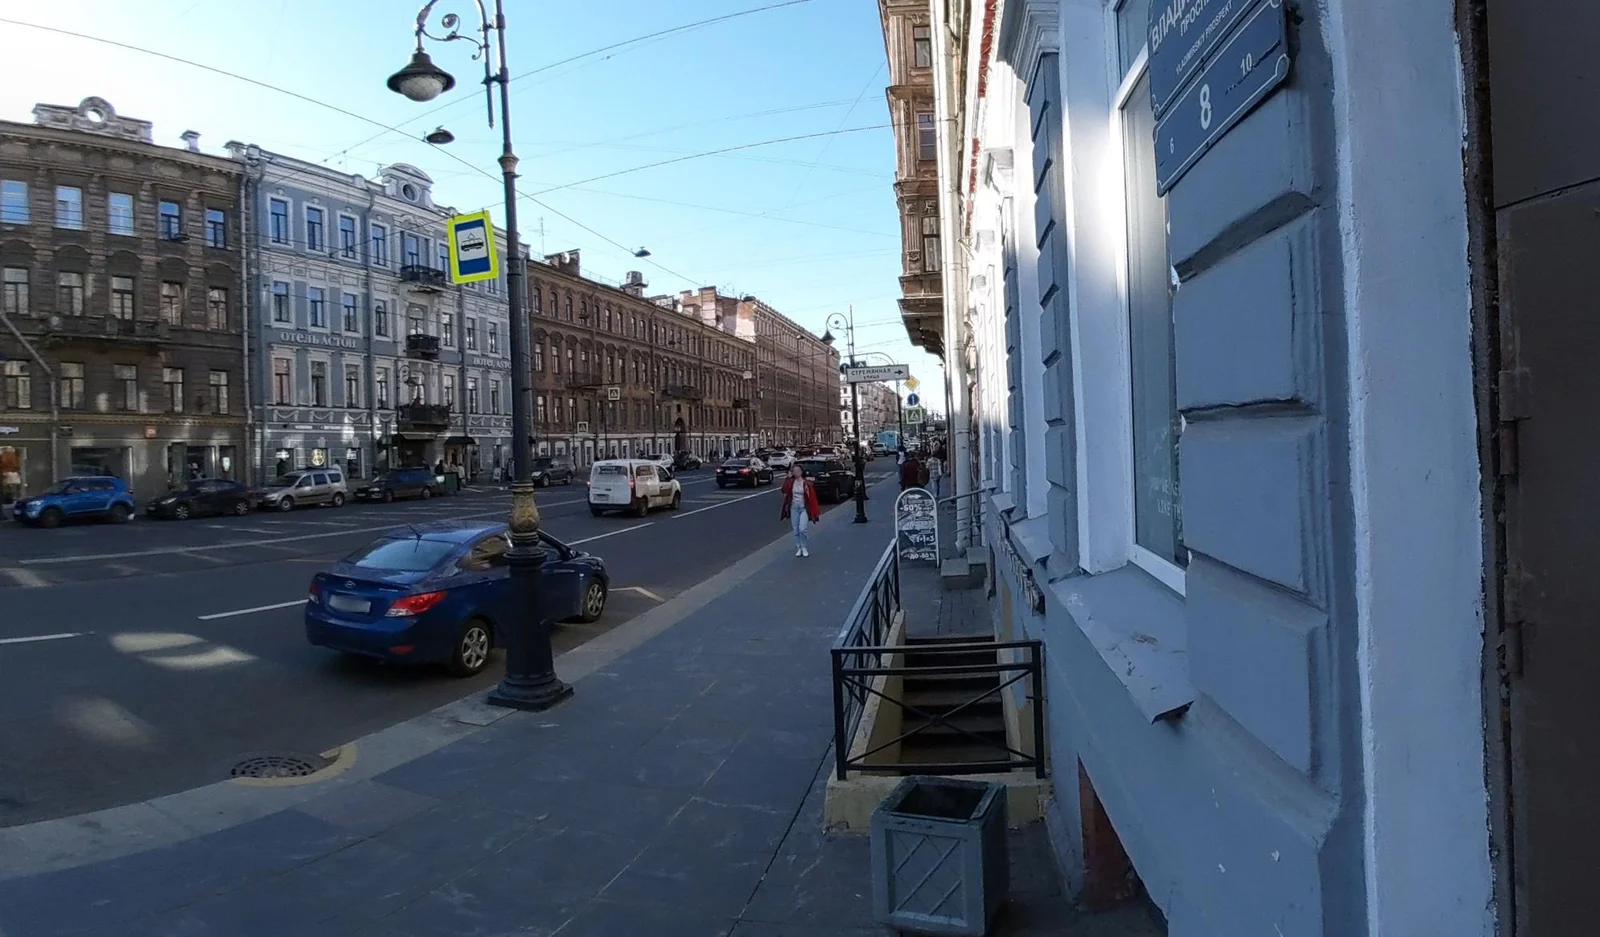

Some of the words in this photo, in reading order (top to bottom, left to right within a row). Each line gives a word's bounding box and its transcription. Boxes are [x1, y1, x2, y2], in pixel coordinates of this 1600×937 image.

[1240, 52, 1253, 76] 10
[1200, 84, 1212, 130] 8
[1169, 137, 1175, 154] 6
[851, 368, 892, 376] СТРЕМЯННАЯ
